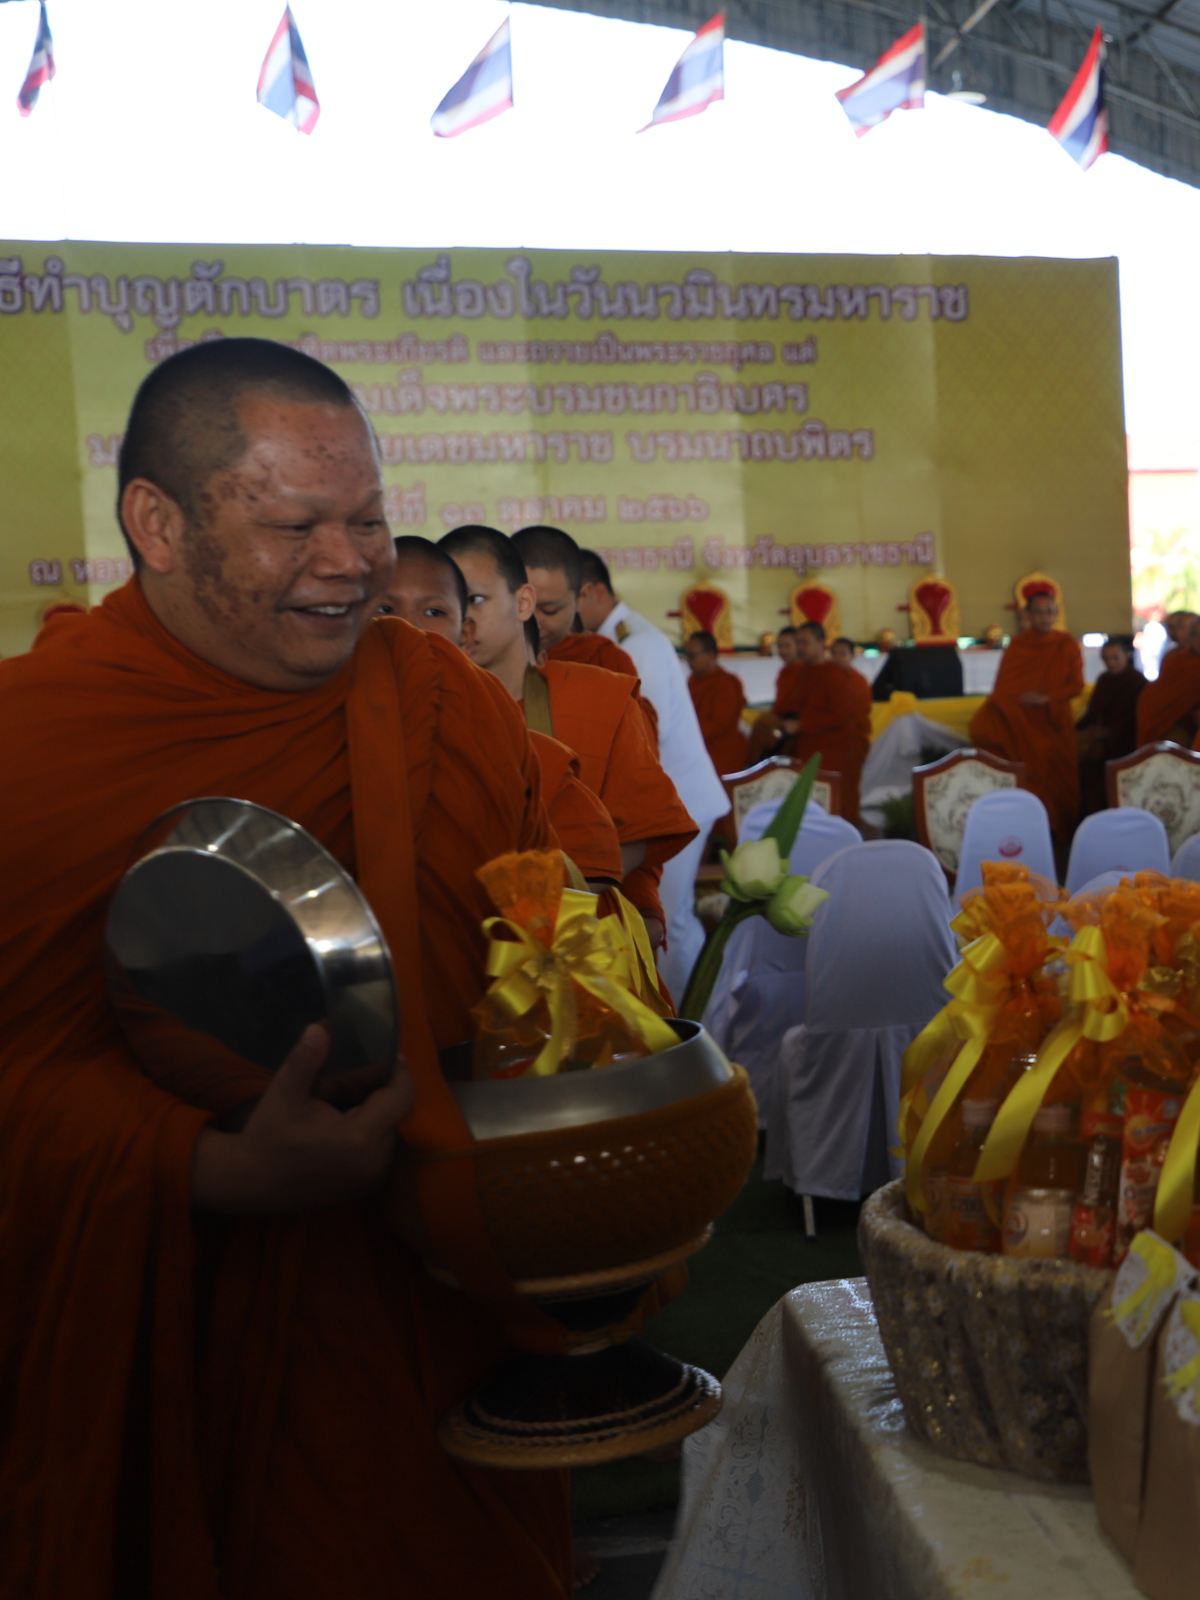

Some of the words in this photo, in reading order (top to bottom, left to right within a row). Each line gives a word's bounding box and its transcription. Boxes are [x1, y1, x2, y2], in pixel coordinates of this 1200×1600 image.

[402, 254, 968, 322] เนื่องในวันนวมินทรมหาราช
[353, 368, 809, 415] มเด็จพระบรมชนกาธิเบศร
[628, 419, 874, 464] บรมนาถบพิตร
[498, 495, 605, 530] ตุลาคม
[617, 494, 709, 522] ๒๕๖๖
[704, 531, 935, 575] จังหวัดอุบลราชธานี
